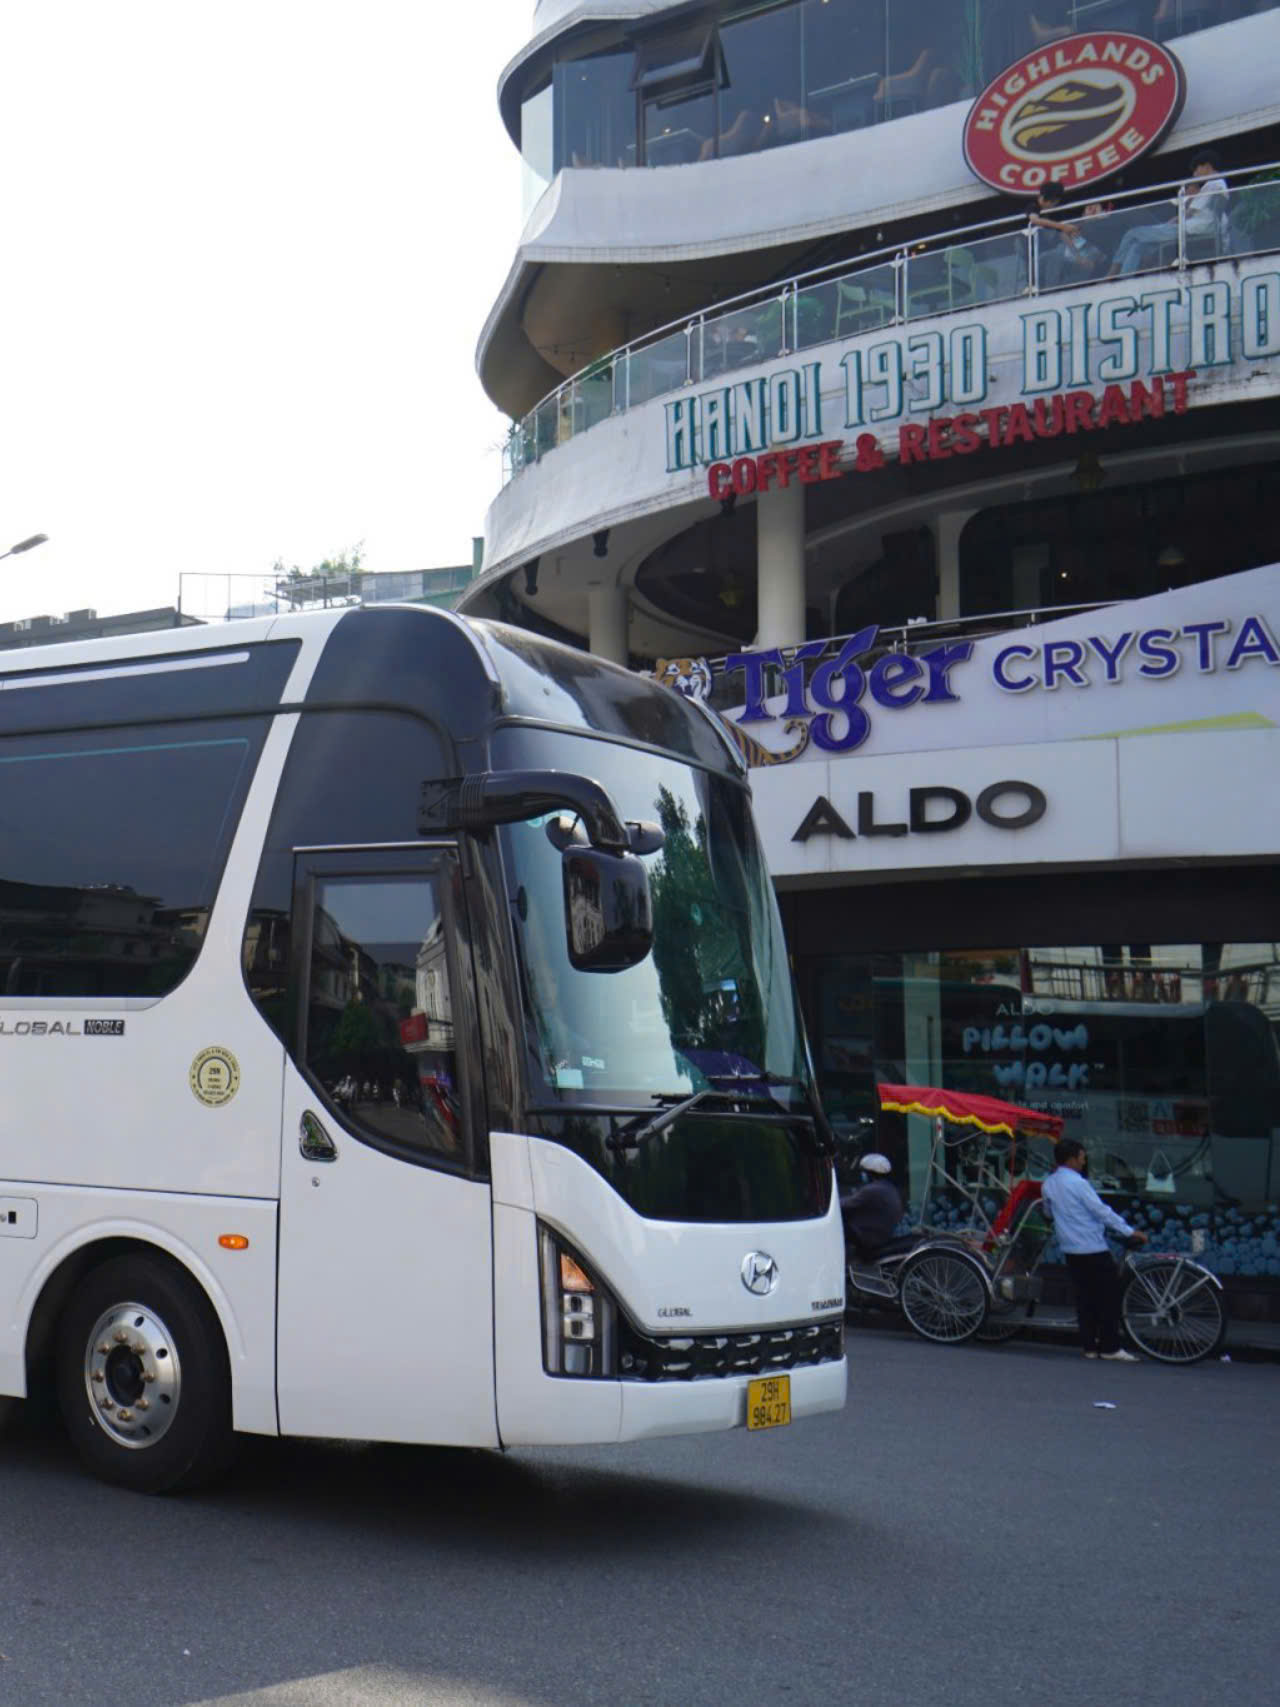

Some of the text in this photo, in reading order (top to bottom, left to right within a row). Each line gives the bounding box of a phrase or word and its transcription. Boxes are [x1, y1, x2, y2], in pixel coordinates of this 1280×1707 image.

[975, 41, 1165, 130] HIGHLANDS
[1000, 127, 1144, 186] COFFEE
[663, 271, 1280, 473] HANOI 1930 BISTRO
[707, 370, 1197, 499] COFFEE & RESTAURANT
[725, 615, 1280, 753] Tiger CRYSTA
[792, 780, 1047, 843] ALDO
[962, 1024, 1088, 1051] PILLOW
[995, 1003, 1055, 1017] ALDO
[993, 1061, 1089, 1089] WALK
[761, 1382, 780, 1403] 29H
